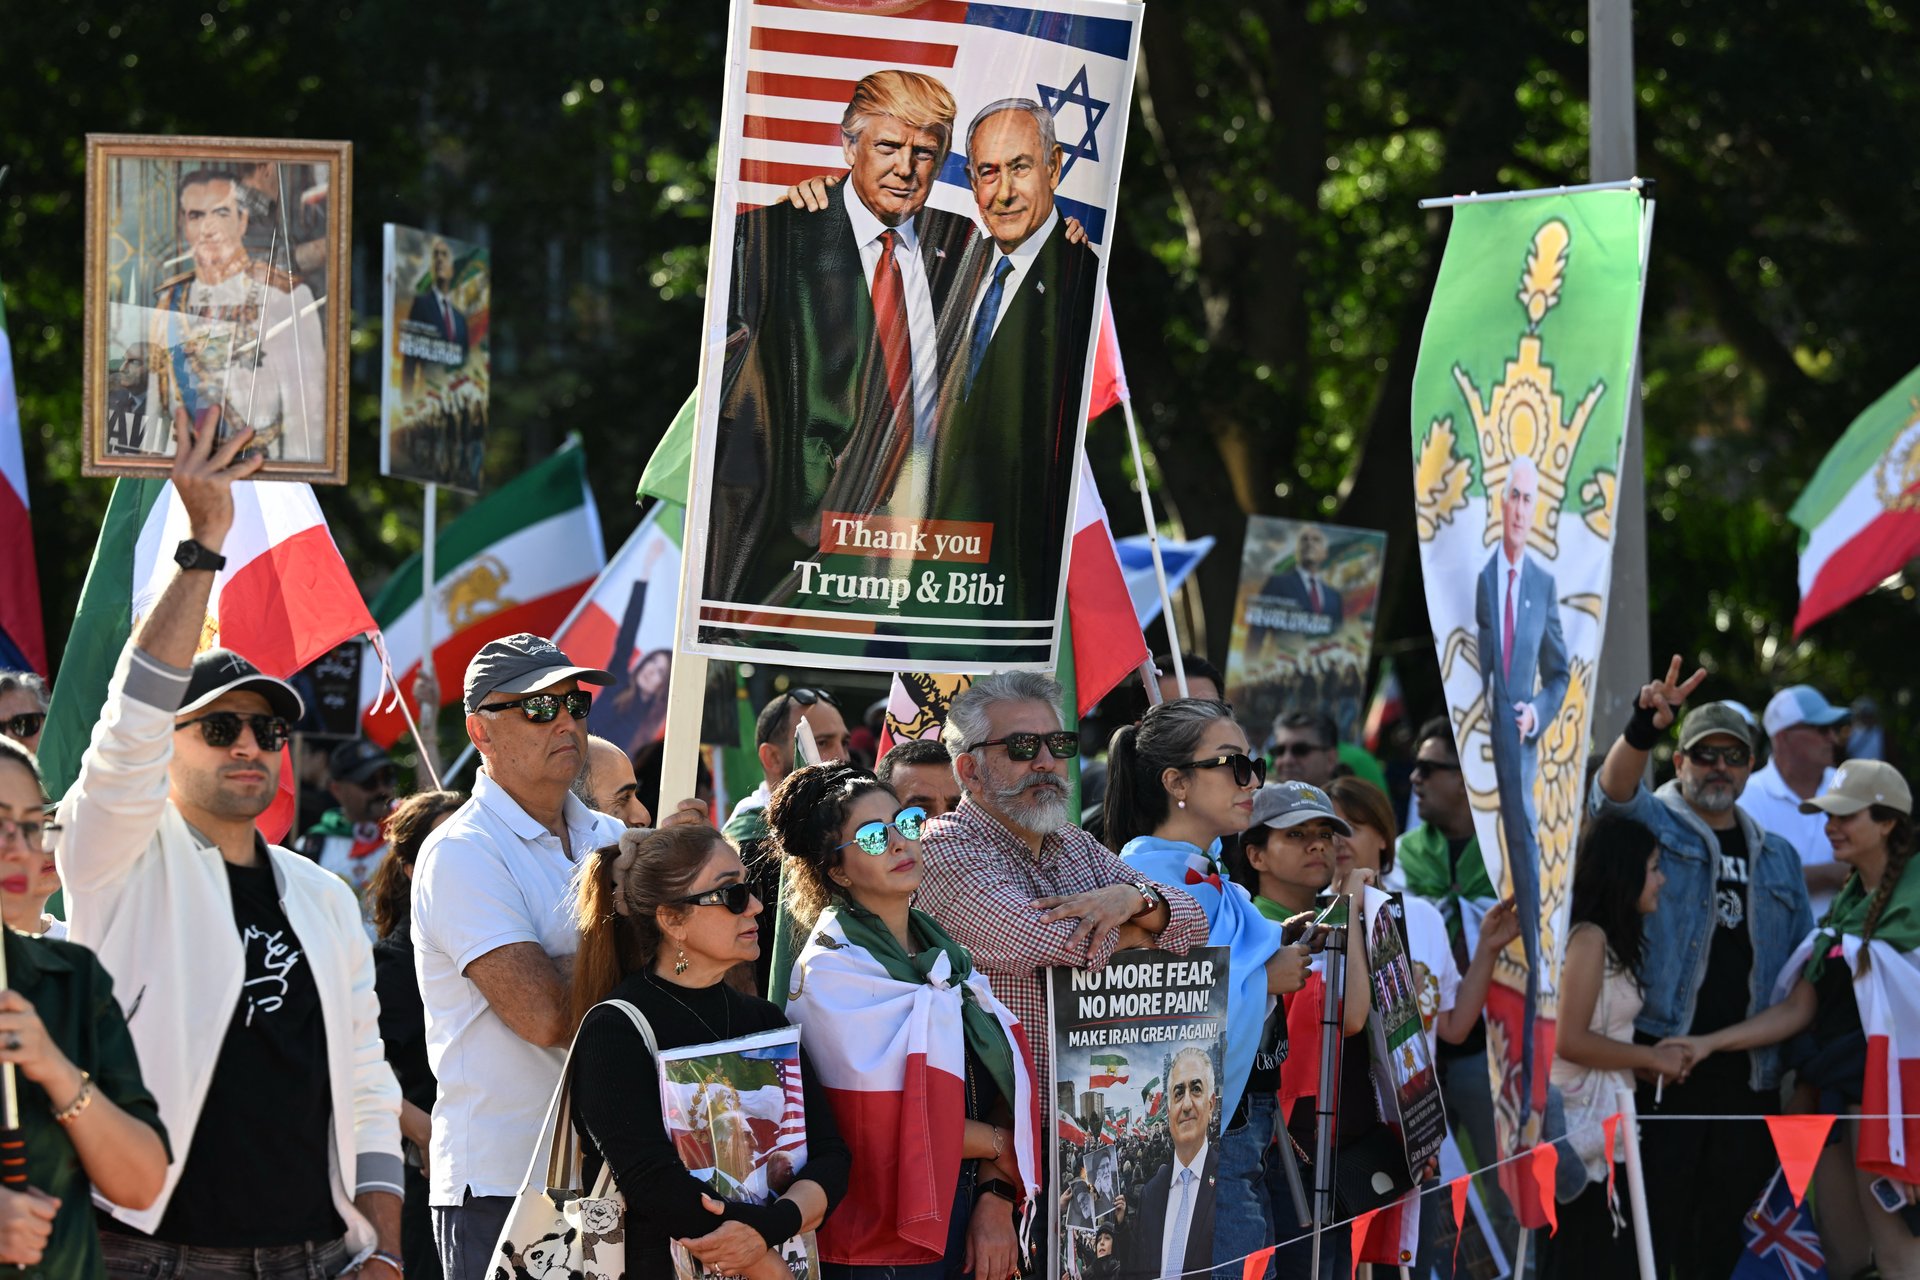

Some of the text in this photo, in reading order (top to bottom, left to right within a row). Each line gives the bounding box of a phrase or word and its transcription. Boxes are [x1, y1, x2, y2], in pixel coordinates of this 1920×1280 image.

[832, 519, 981, 560] Thank you
[793, 561, 1006, 609] Trump & Bibi
[1071, 960, 1217, 991] NO MORE FEAR,
[1078, 989, 1210, 1019] NO MORE PAIN!
[1068, 1023, 1217, 1048] MAKE IRAN GREAT AGAIN!
[787, 1261, 809, 1273] GAIN
